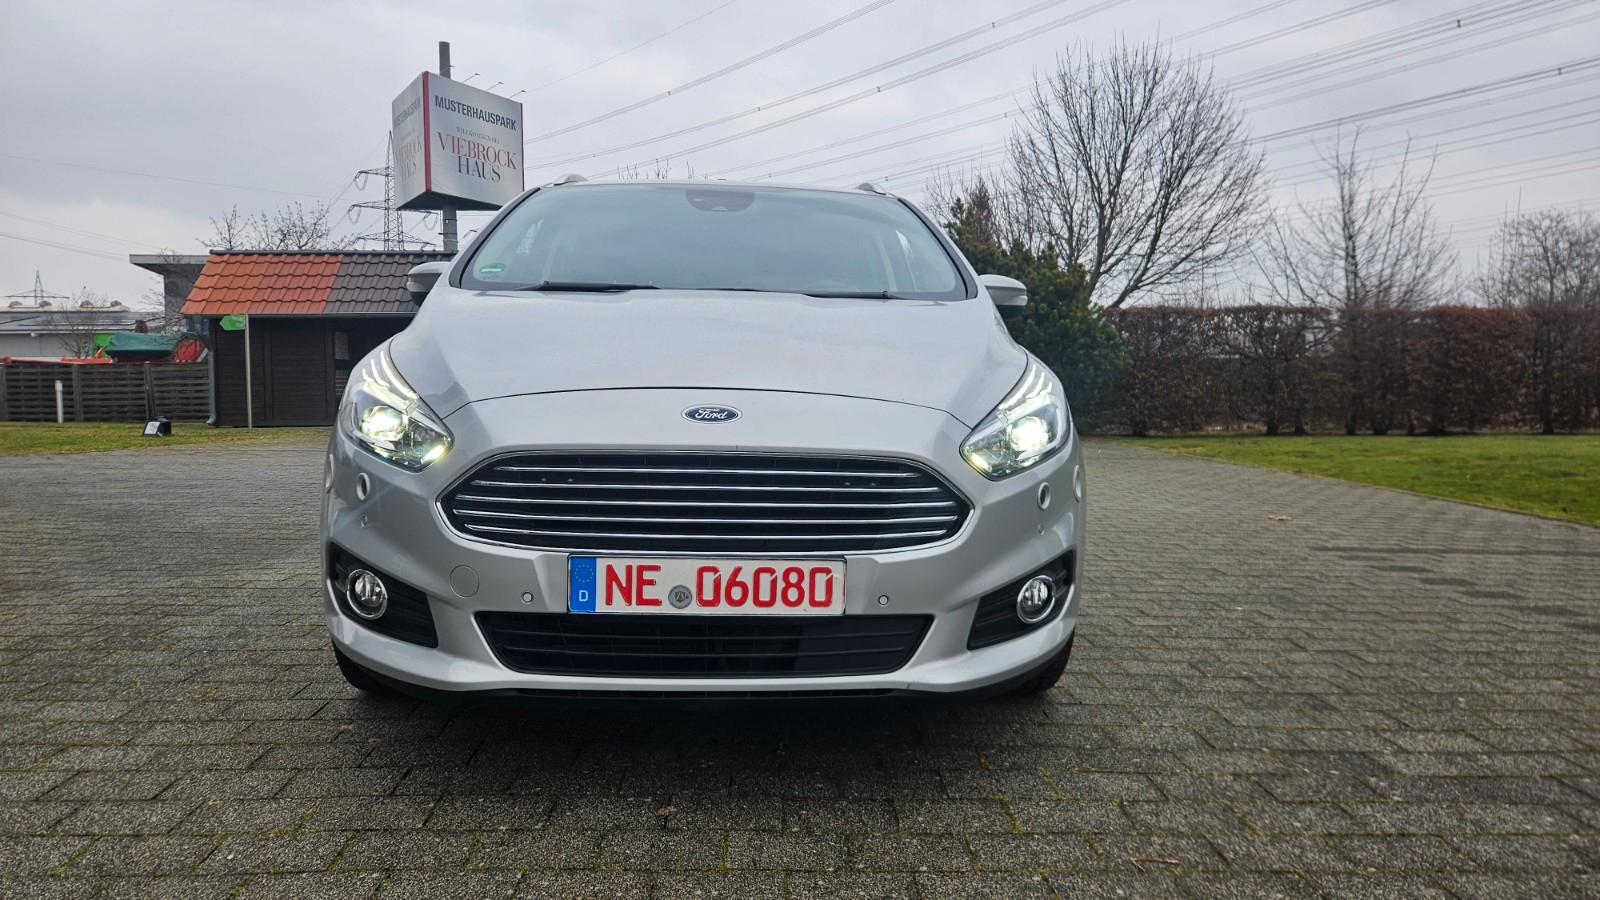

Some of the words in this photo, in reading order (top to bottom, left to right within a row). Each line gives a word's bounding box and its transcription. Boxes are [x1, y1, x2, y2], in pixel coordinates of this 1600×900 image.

[434, 94, 517, 131] MUSTERHAUSPARK
[436, 131, 517, 170] VIEBROCK
[457, 155, 501, 183] HAUS
[694, 408, 728, 419] Ford
[578, 590, 589, 602] D
[605, 564, 663, 607] NE
[695, 565, 834, 608] 06080
